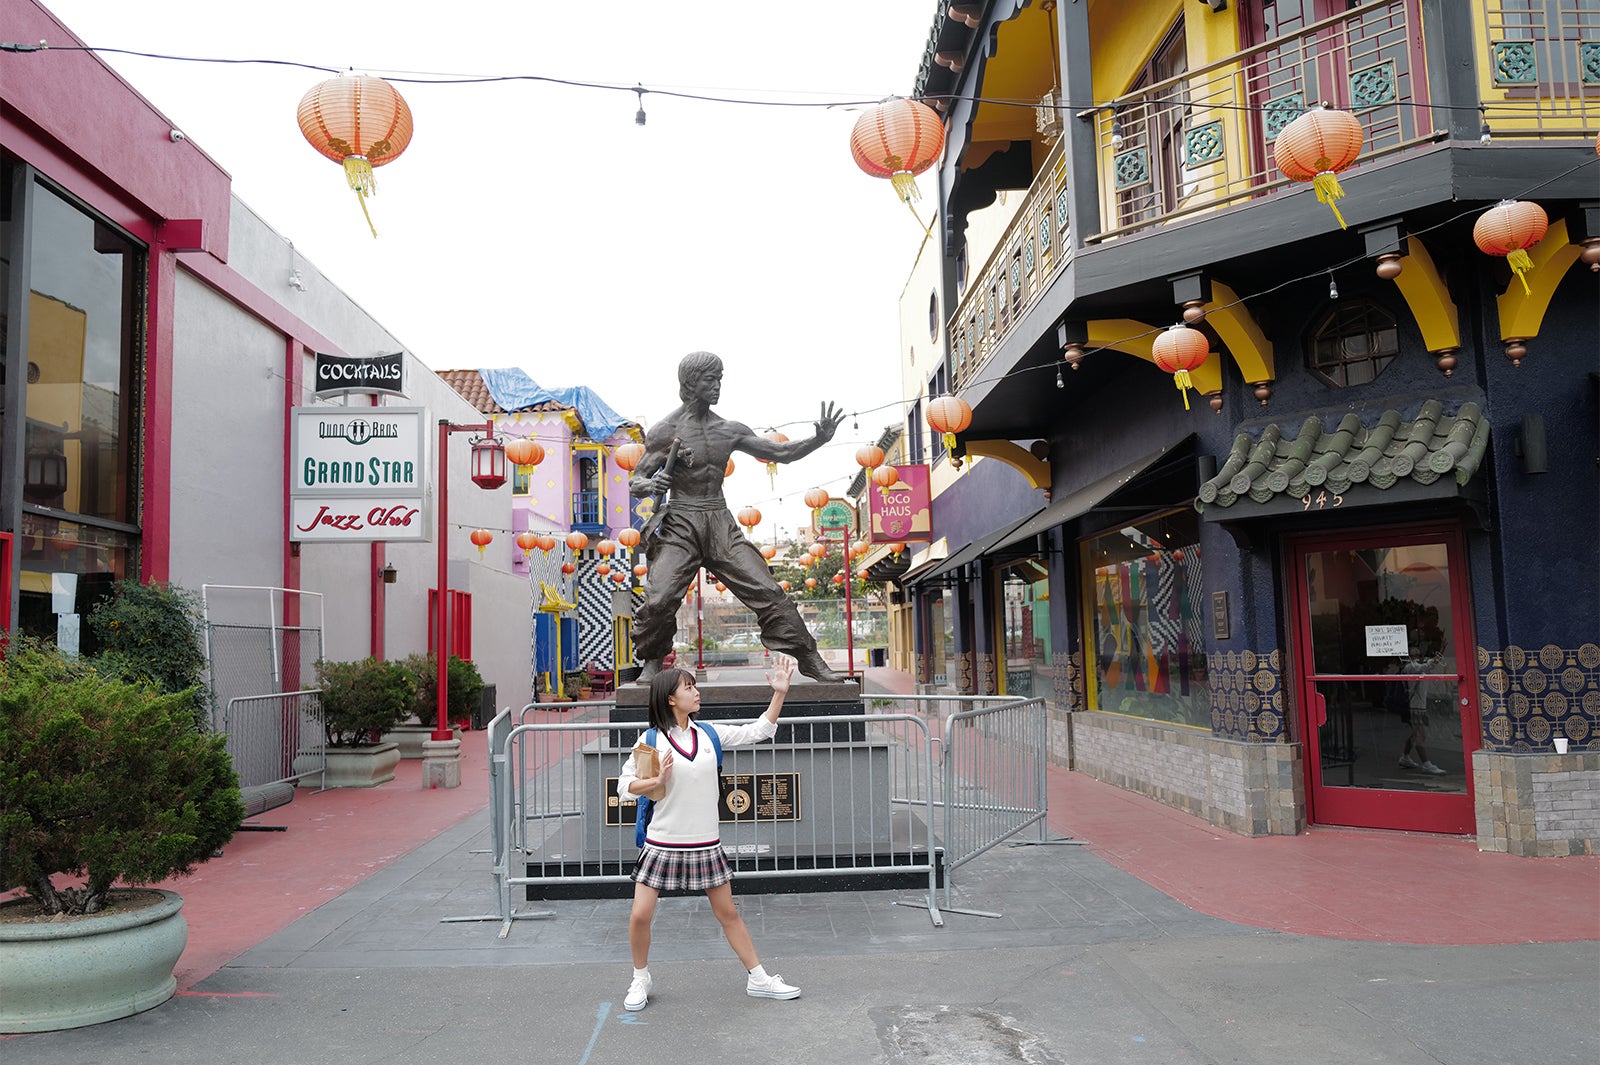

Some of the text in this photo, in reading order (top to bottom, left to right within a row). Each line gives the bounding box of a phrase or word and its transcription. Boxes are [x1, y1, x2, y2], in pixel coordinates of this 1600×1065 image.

[320, 363, 401, 380] COCKTAILS
[1302, 490, 1344, 511] 945
[297, 505, 419, 532] Jazz Club
[881, 506, 911, 516] HAUS
